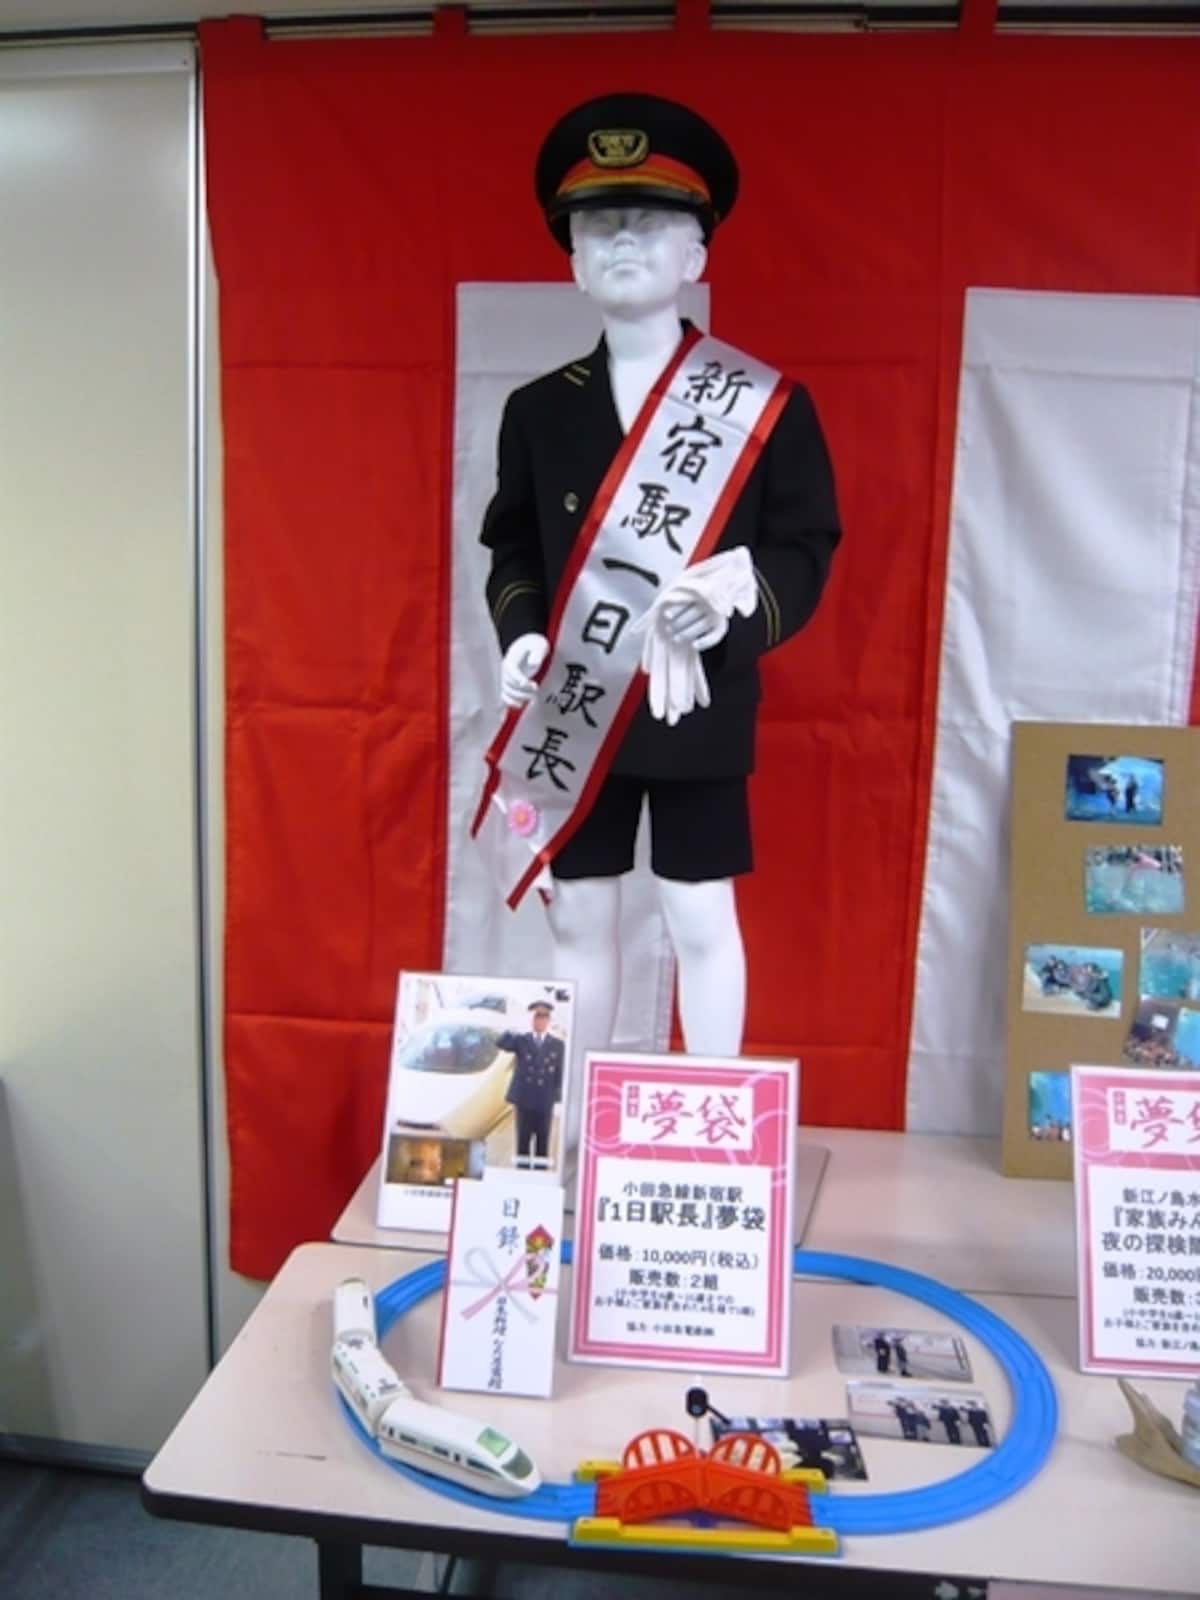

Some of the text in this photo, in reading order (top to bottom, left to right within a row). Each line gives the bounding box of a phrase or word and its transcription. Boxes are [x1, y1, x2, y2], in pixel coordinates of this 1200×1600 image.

[521, 360, 755, 794] 新宿駅一日駅長
[641, 1089, 747, 1145] 夢袋
